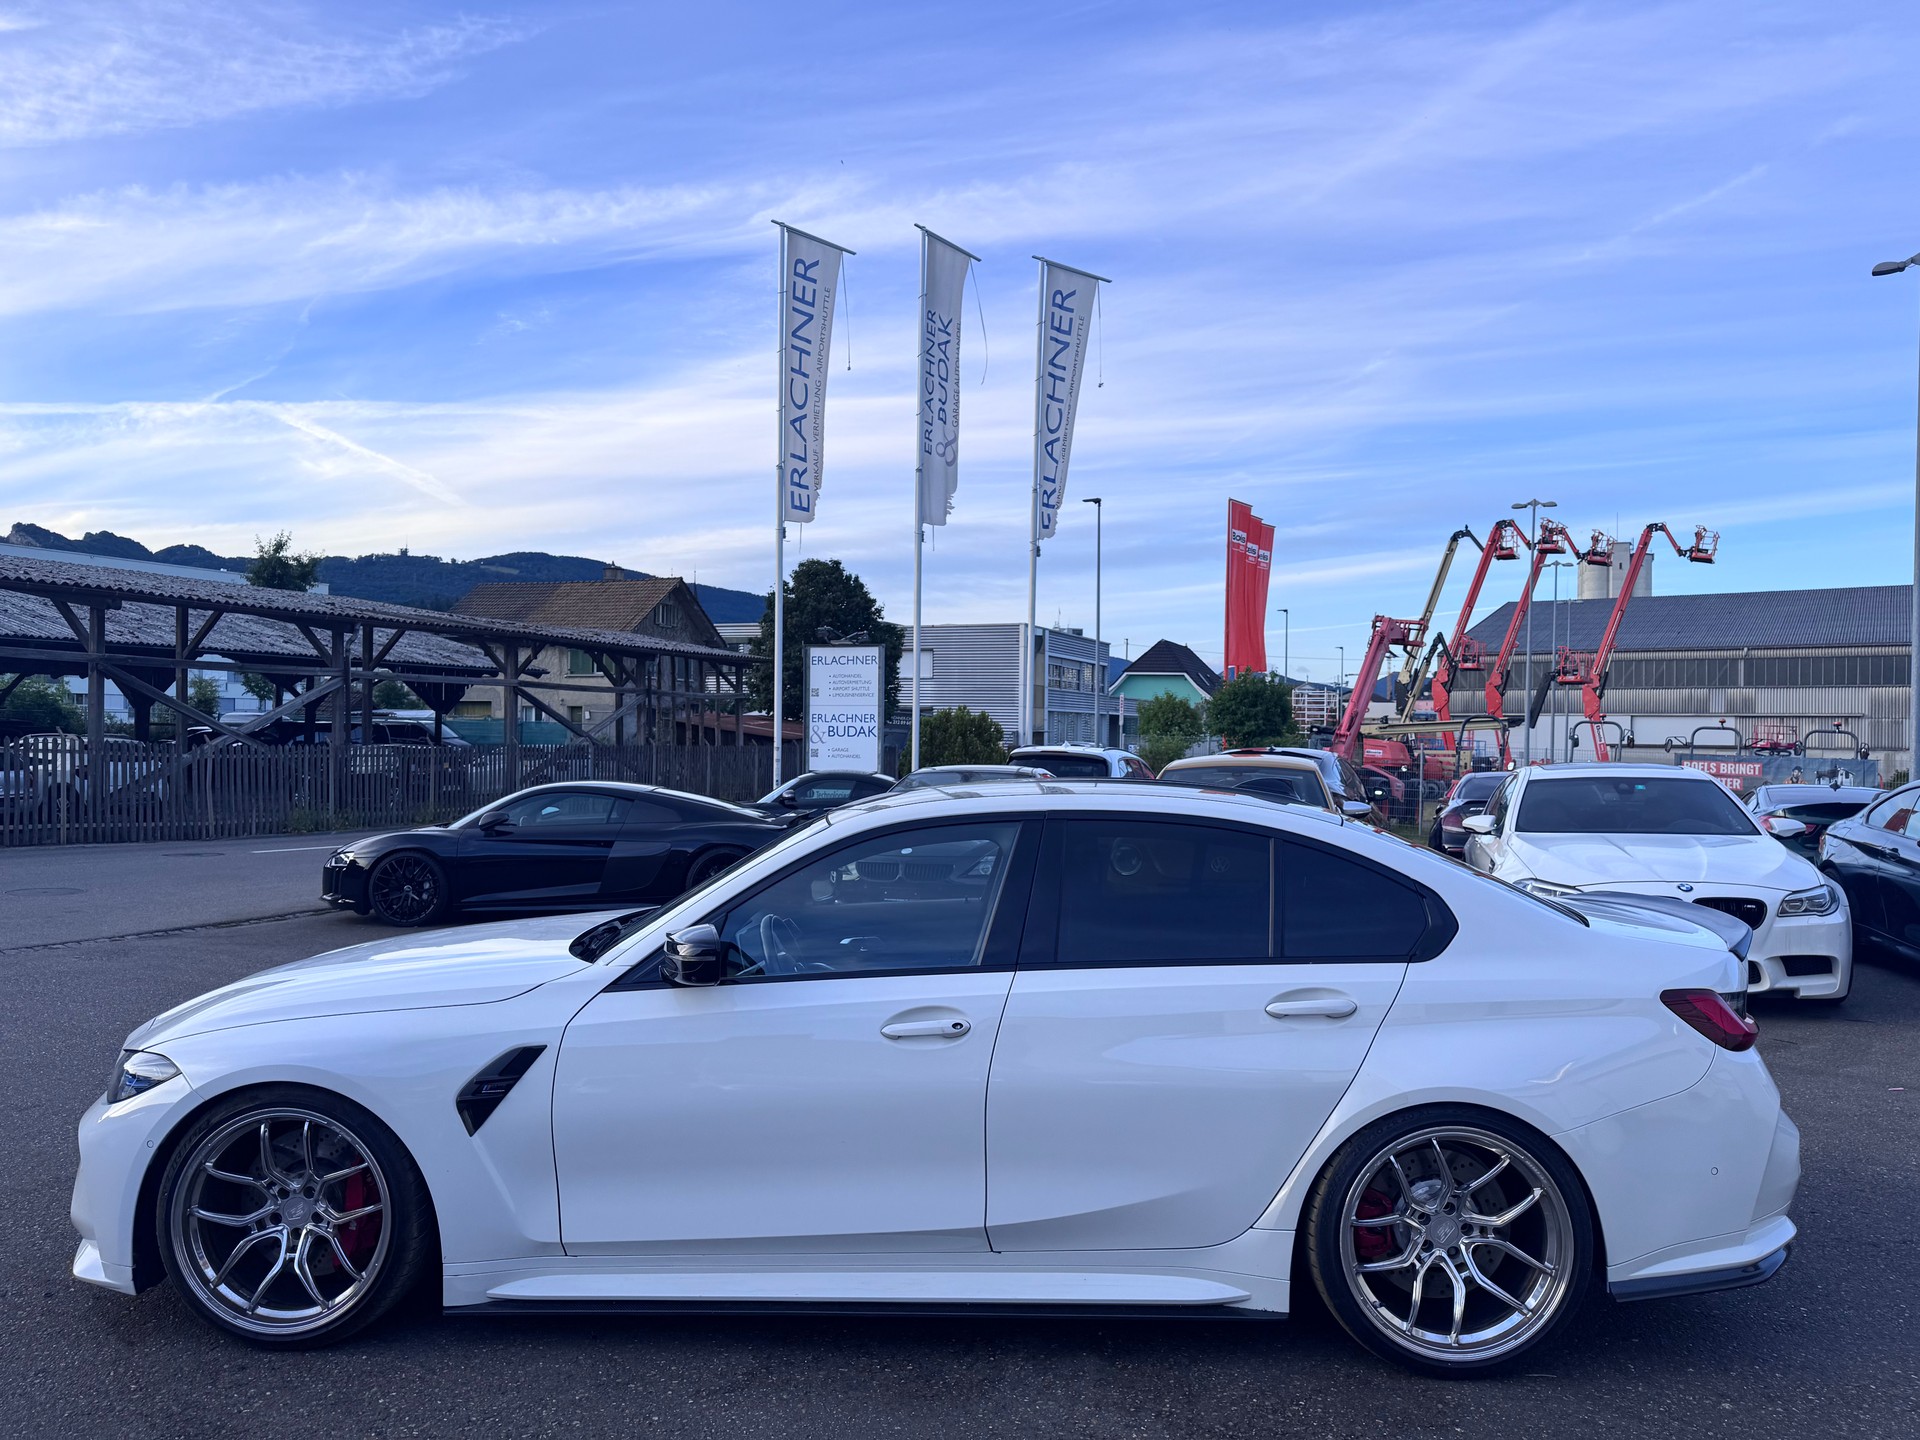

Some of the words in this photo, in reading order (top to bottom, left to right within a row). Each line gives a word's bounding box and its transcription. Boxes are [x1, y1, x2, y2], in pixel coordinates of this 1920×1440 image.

[815, 286, 831, 374] AIRPORTSHUTTLE
[789, 258, 820, 513] ERLACHNER
[924, 309, 937, 456] ERLACHNER
[937, 313, 953, 425] BUDAK
[812, 380, 822, 443] VERMIETUNG
[952, 392, 961, 428] GARAGE
[1041, 289, 1077, 530] ERLACHNER
[935, 425, 957, 467] &
[812, 449, 821, 491] VERKAUF
[811, 655, 878, 666] ERLACHNER
[810, 724, 827, 744] &
[827, 725, 877, 738] BUDAK
[811, 713, 877, 723] ERLACHNER
[1719, 763, 1761, 775] BRINGT
